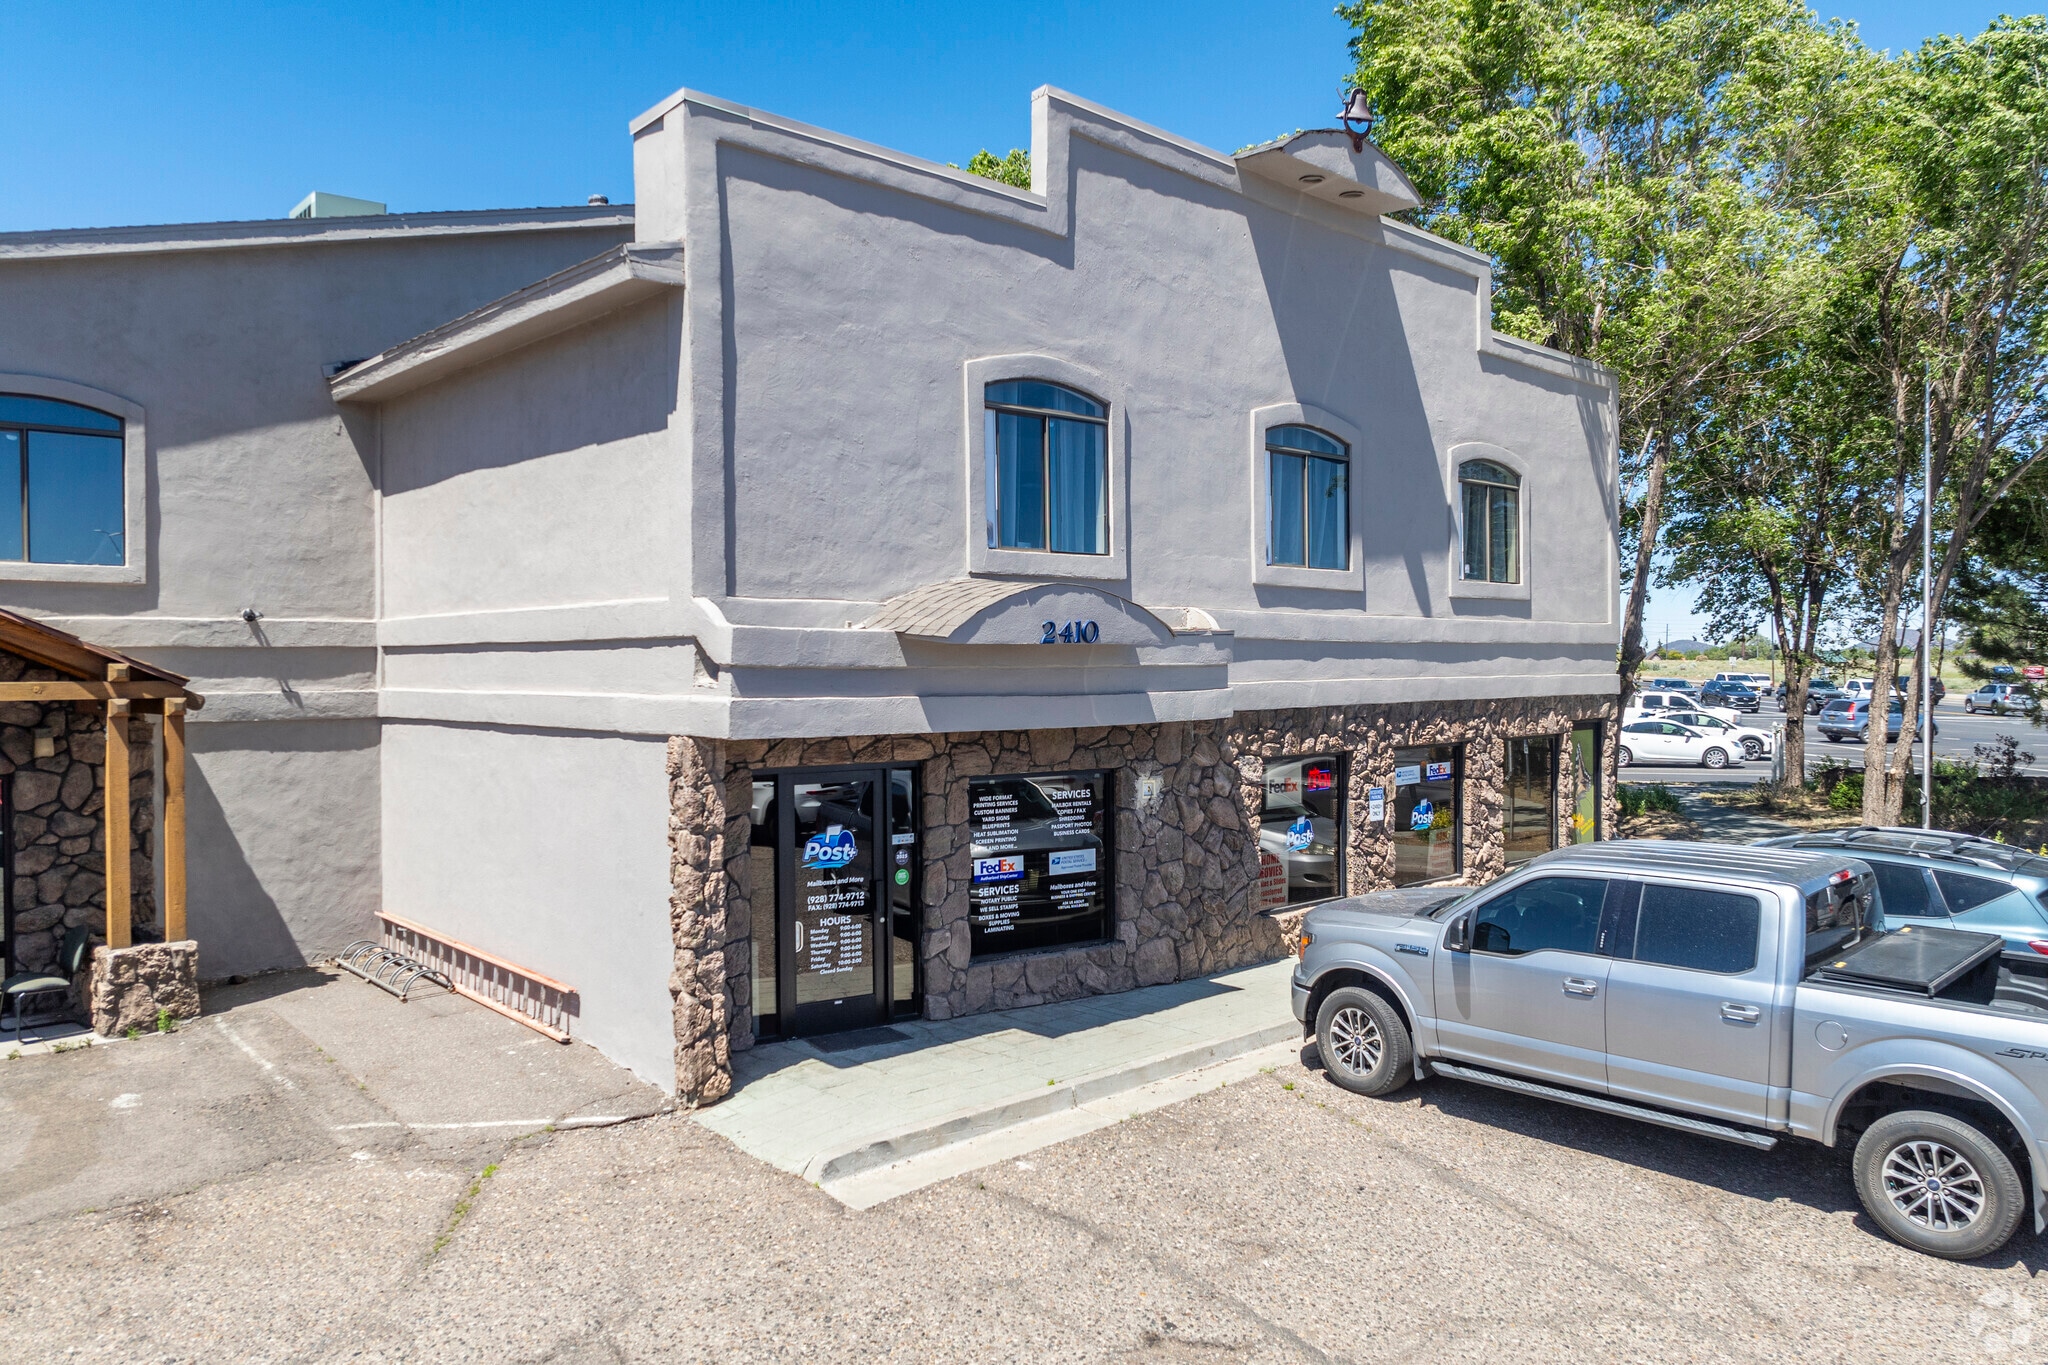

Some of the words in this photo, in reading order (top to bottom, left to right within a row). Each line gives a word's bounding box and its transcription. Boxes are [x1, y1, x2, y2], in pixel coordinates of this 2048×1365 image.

[1040, 619, 1100, 644] 2410
[1429, 763, 1447, 775] FedEx
[1268, 777, 1298, 794] FedEx
[1052, 789, 1091, 800] SERVICES
[980, 858, 1015, 874] FedEx
[806, 879, 837, 888] Mailboxes
[837, 877, 849, 885] and
[978, 884, 1020, 897] SERVICES
[807, 894, 828, 905] (928)
[829, 891, 865, 902] 774-9712
[820, 915, 851, 926] HOURS
[984, 925, 1014, 933] LAMINATING
